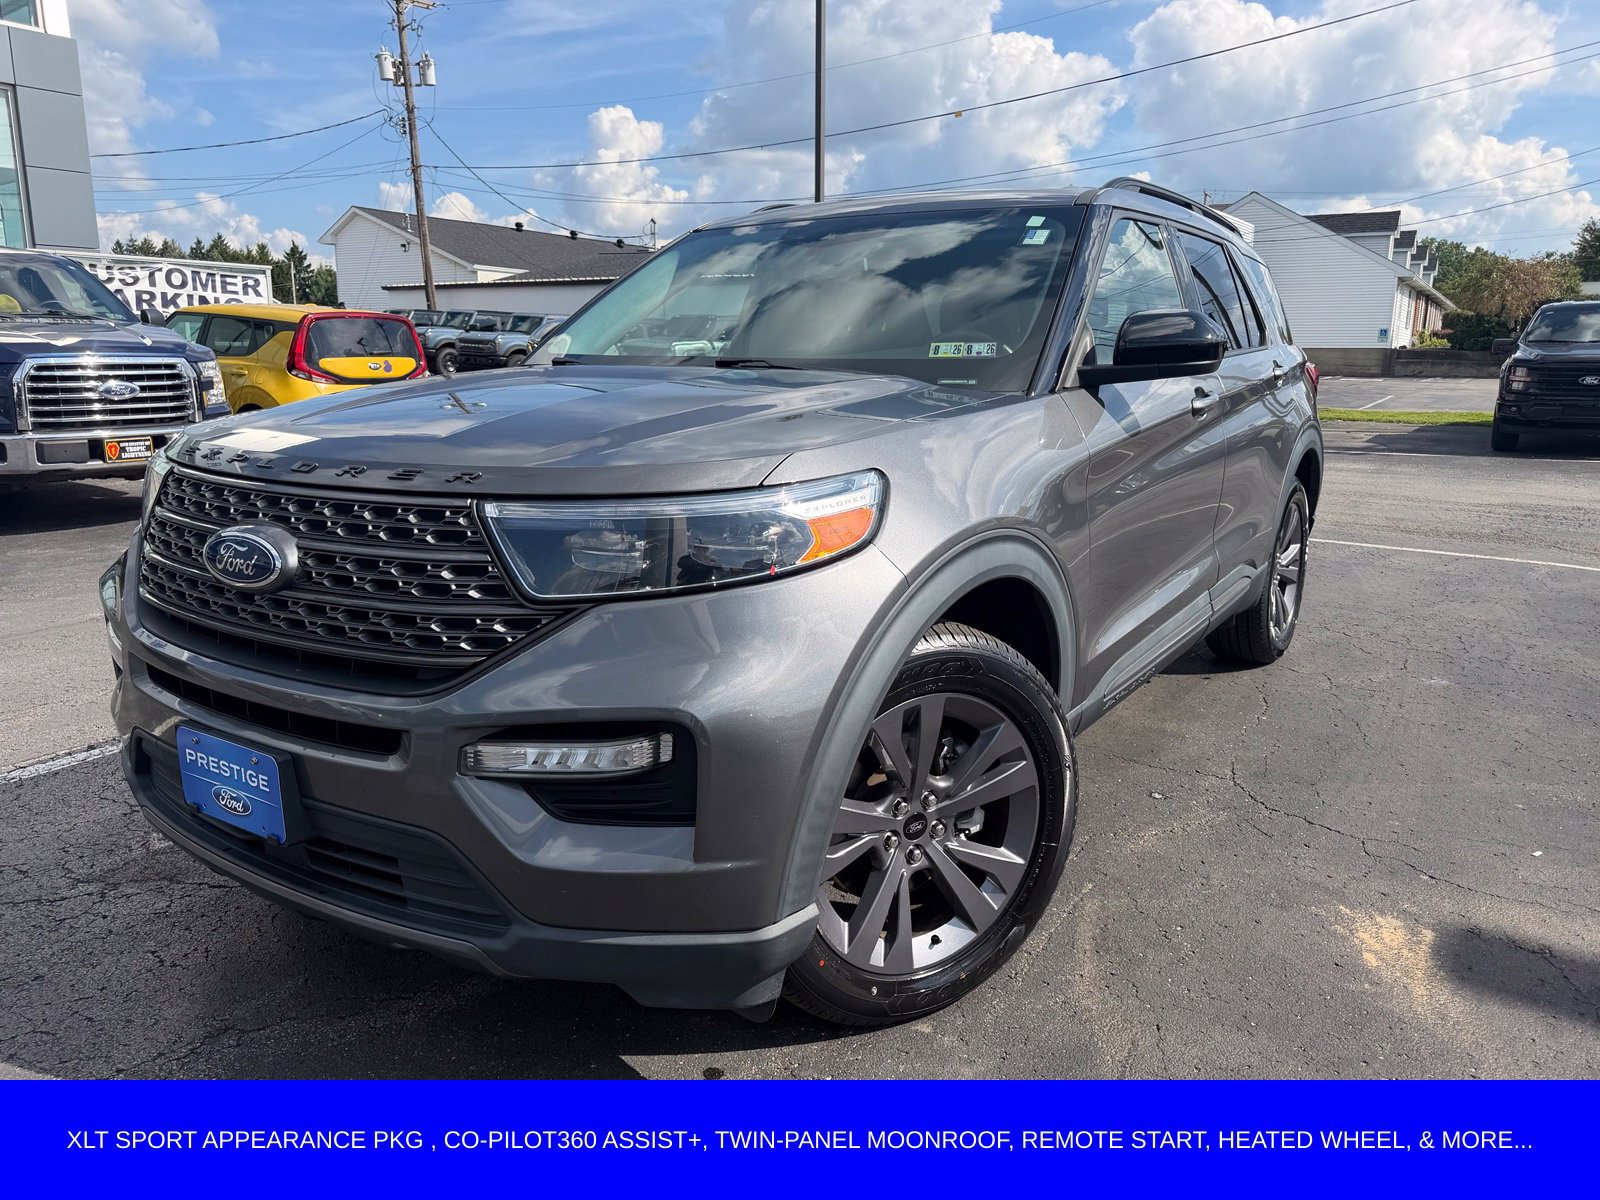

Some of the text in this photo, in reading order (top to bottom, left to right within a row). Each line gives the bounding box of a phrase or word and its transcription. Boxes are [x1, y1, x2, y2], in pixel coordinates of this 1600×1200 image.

[76, 261, 263, 298] USTOMER
[933, 344, 962, 355] 8 26
[966, 344, 995, 355] 8 26
[111, 386, 130, 395] Ford
[183, 441, 483, 484] EXPLORER
[804, 495, 866, 514] EXPLORER
[215, 542, 258, 576] Ford
[185, 748, 270, 792] PRESTIGE
[219, 788, 244, 813] Ford
